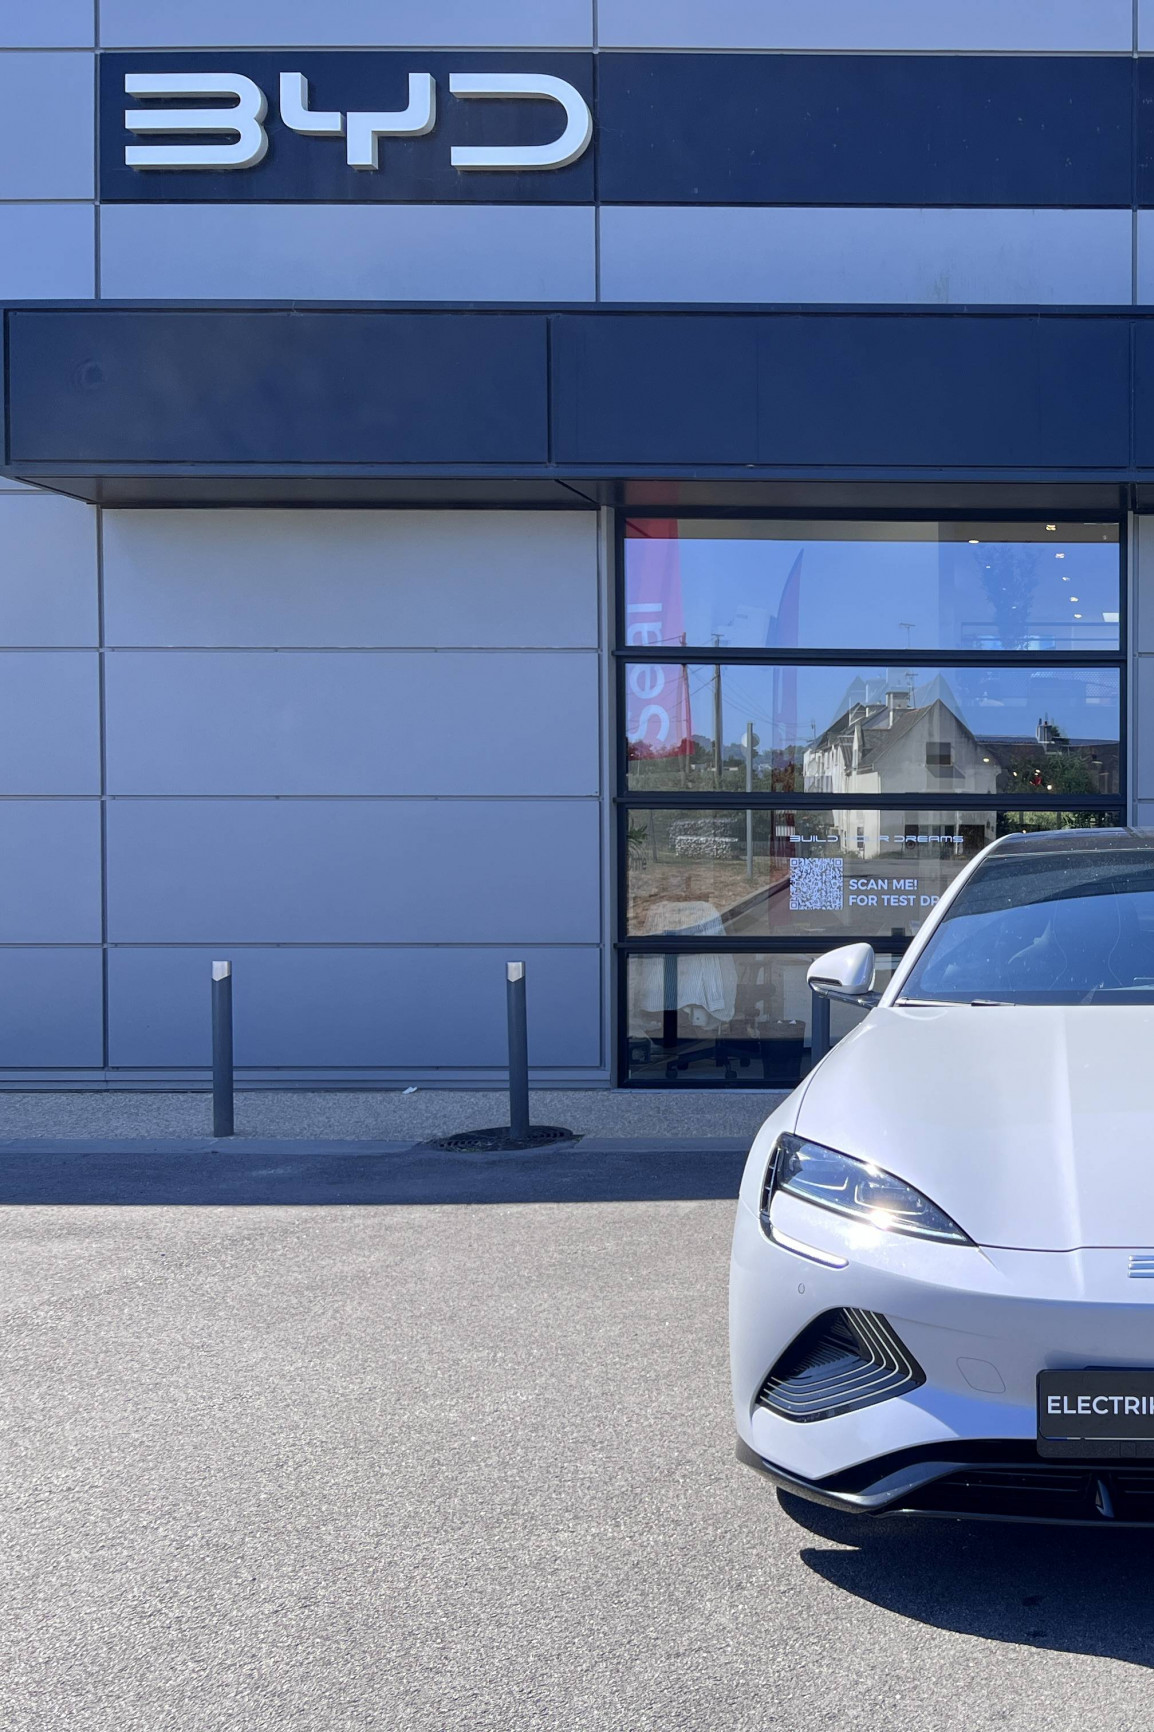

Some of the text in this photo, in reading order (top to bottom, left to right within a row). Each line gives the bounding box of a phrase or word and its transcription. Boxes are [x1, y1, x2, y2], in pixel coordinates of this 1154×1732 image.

[125, 72, 592, 172] BYD
[789, 835, 838, 843] BUILD
[894, 835, 963, 843] DREAMS
[849, 879, 918, 890] SCAN ME!
[849, 895, 877, 906] FOR
[881, 895, 916, 906] TEST
